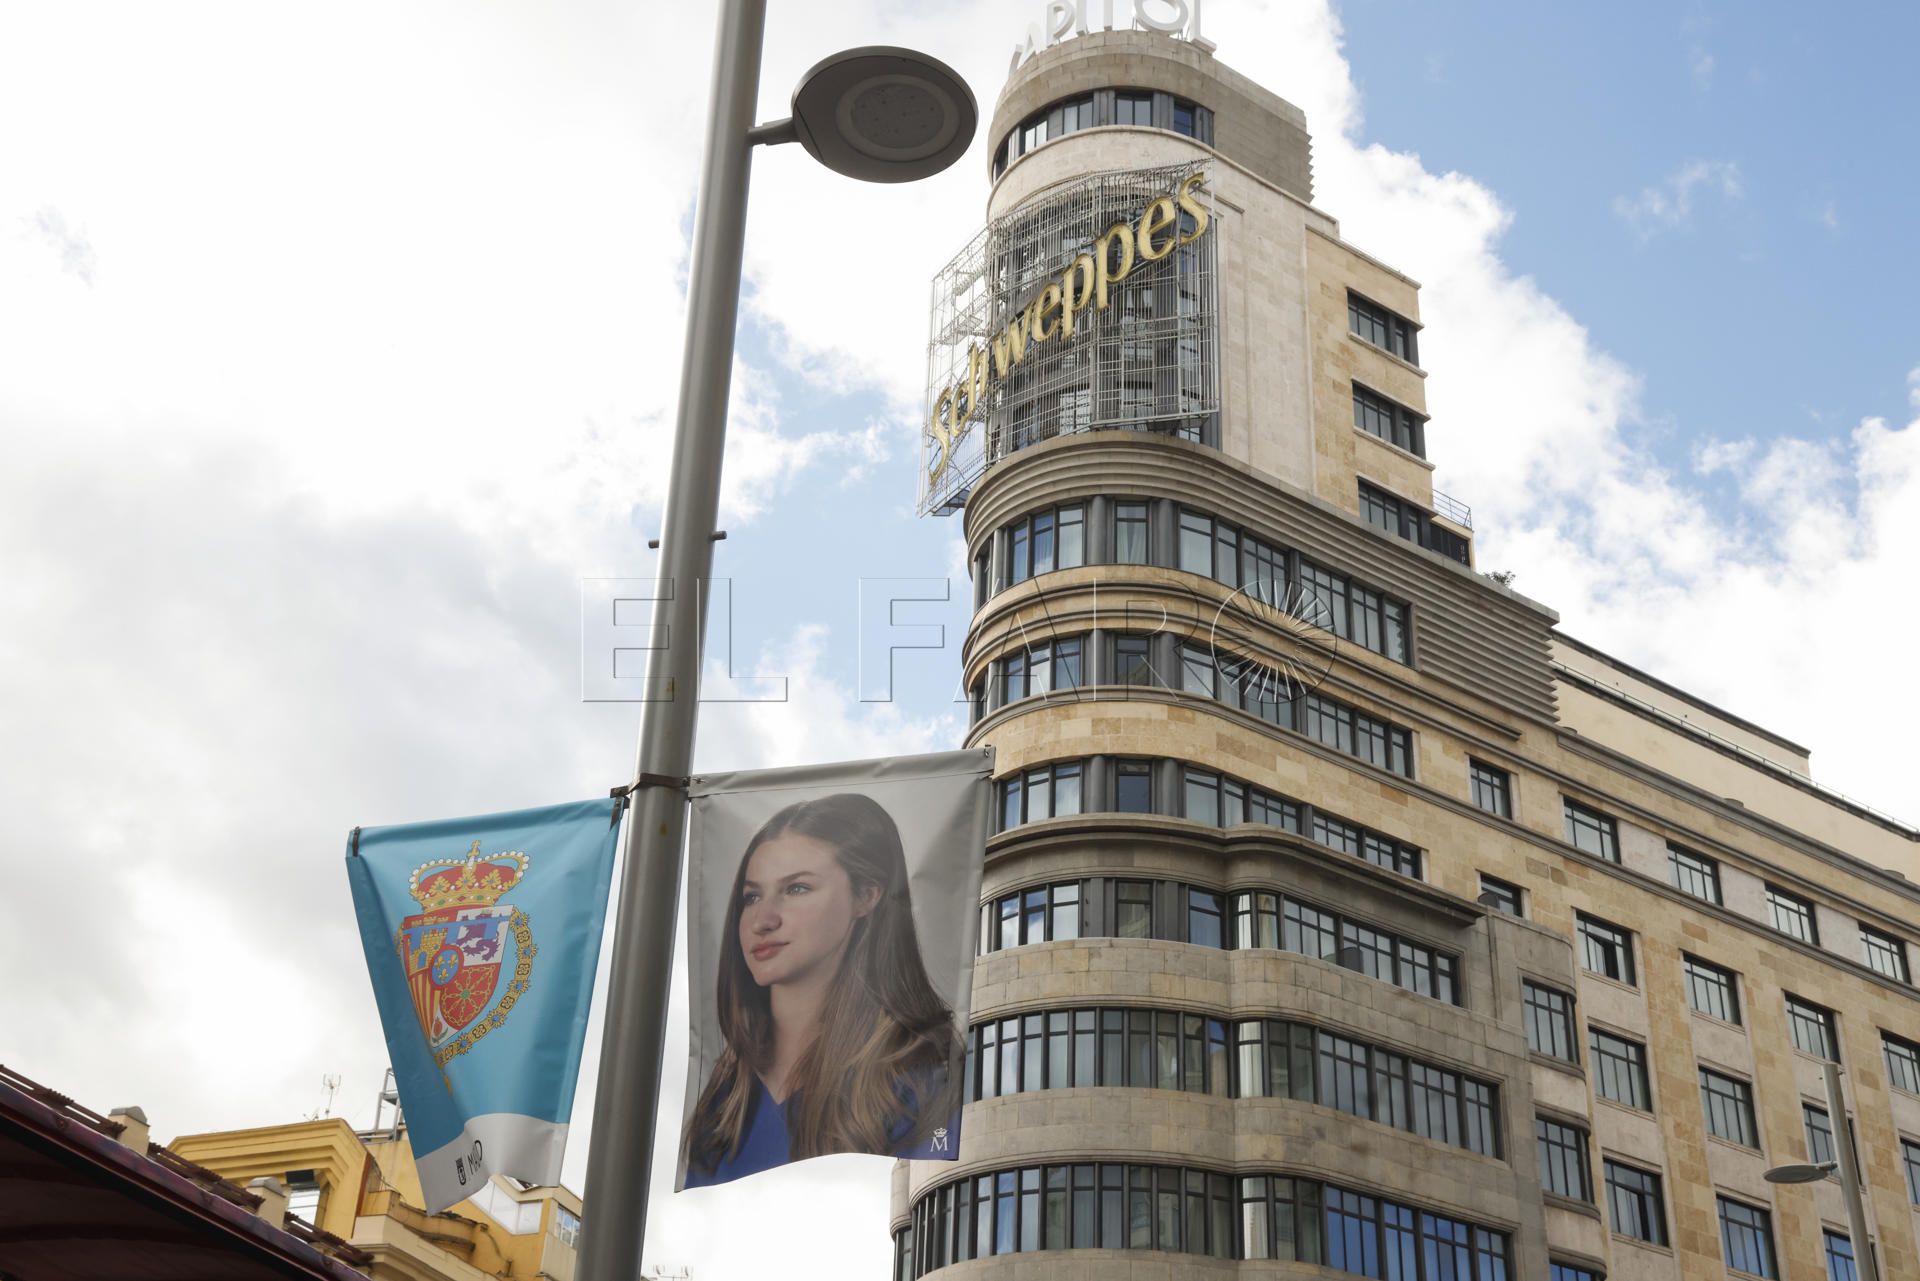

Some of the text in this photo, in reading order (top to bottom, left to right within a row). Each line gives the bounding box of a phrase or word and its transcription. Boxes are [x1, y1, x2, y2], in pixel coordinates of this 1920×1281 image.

[1008, 0, 1216, 72] APIOL
[929, 171, 1210, 485] Schweppes
[930, 1136, 948, 1152] M
